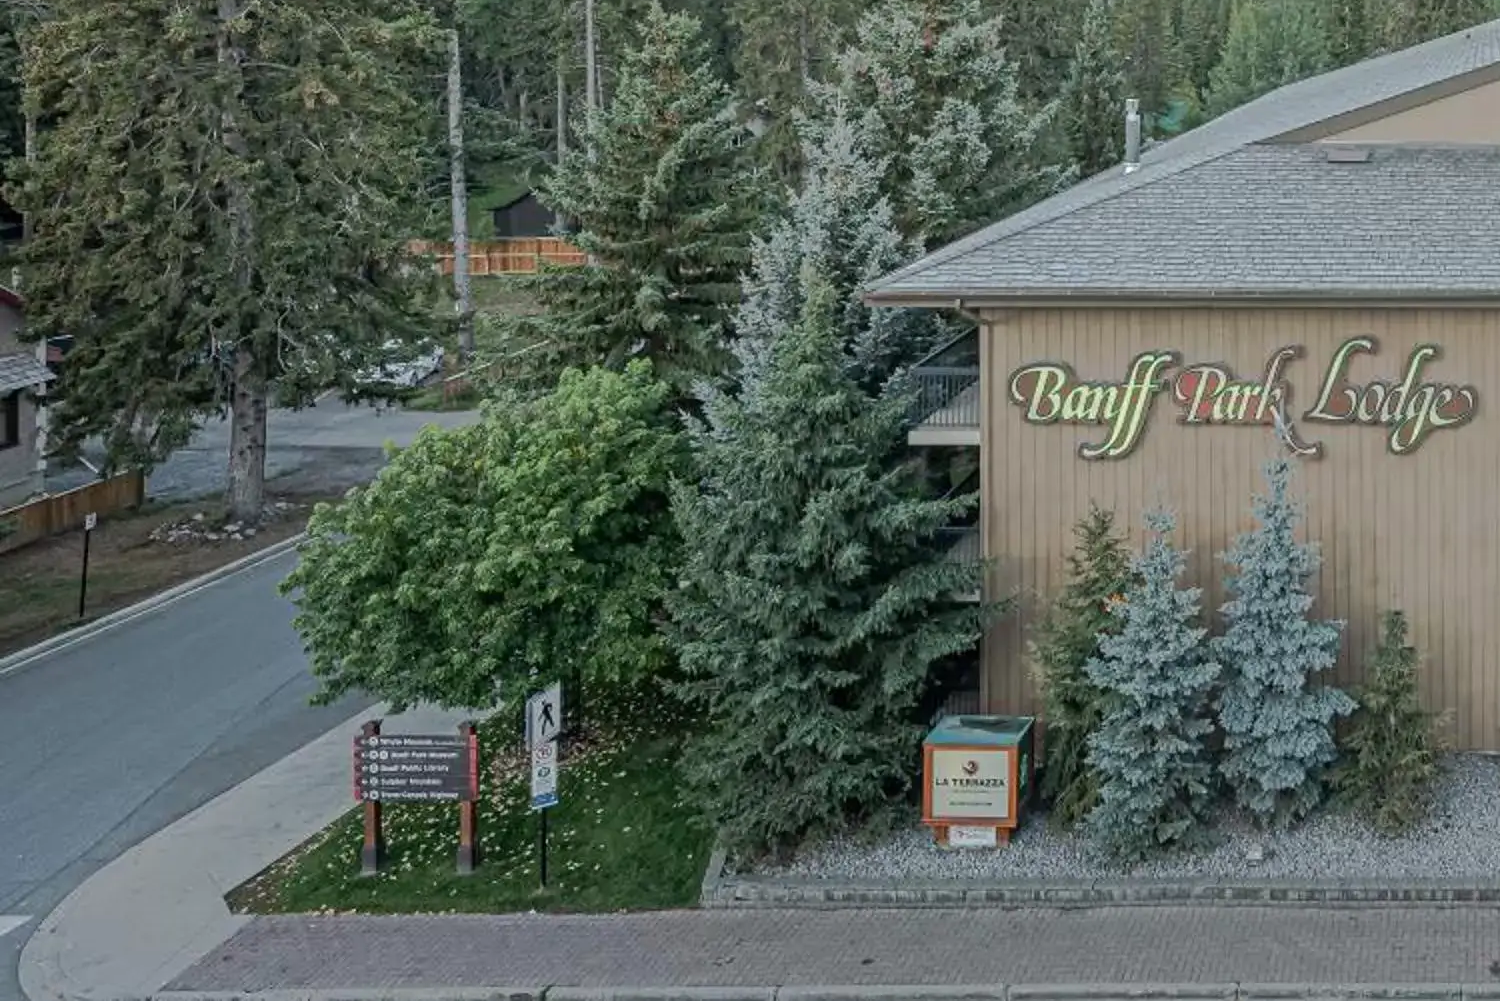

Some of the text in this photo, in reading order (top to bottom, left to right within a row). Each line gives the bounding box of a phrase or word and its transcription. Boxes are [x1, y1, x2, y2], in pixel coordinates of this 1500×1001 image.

[1010, 335, 1476, 458] Banff Park Lodge
